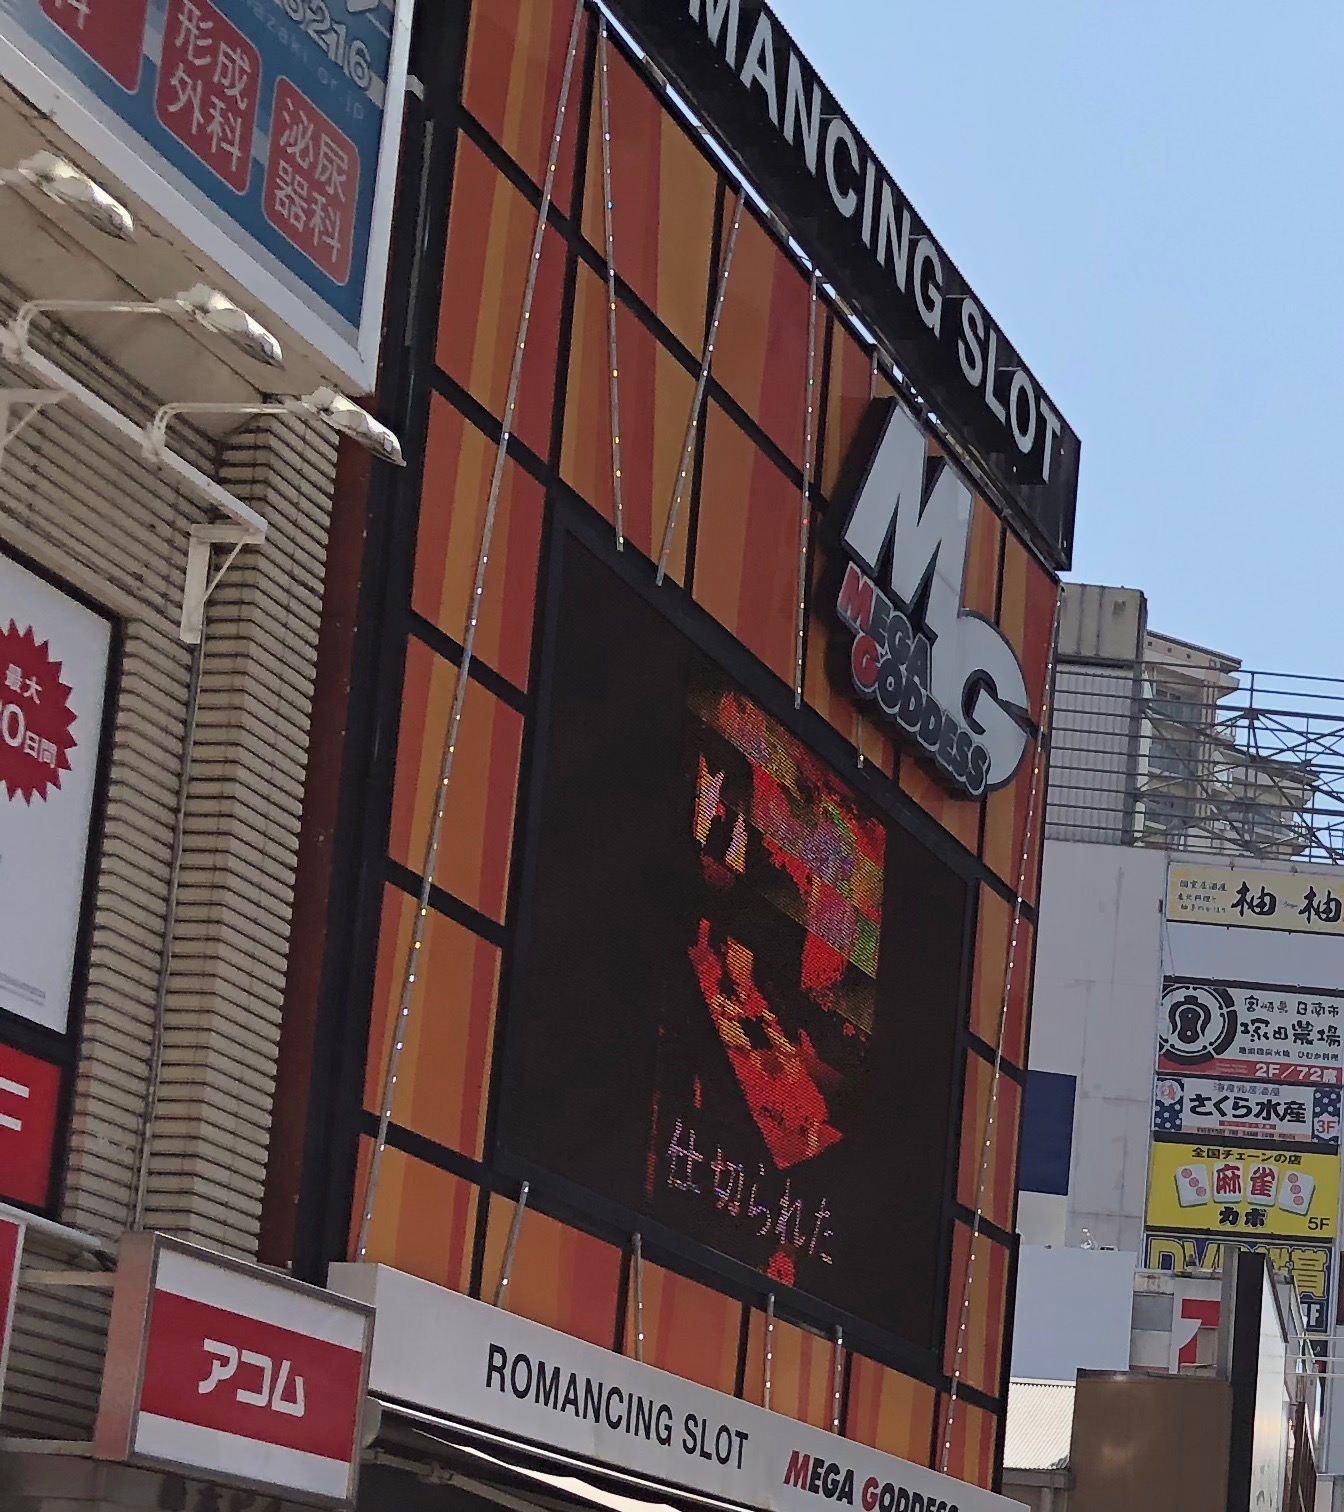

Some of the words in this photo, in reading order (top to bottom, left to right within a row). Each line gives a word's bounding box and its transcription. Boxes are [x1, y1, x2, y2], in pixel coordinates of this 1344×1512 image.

[174, 2, 251, 110] 形成
[168, 62, 242, 172] 外科
[279, 97, 348, 202] 泌尿
[273, 158, 341, 263] 器科
[958, 297, 1061, 484] SLOT
[837, 562, 934, 696] MEGA
[0, 700, 57, 769] 0日間
[851, 632, 990, 797] GODDESS
[1239, 1017, 1341, 1047] 塚田農場
[1296, 1000, 1339, 1018] 日南市
[1188, 1093, 1307, 1124] さくら水産
[1315, 1119, 1337, 1135] 3F
[1191, 1147, 1303, 1166] 全国チェーンの店
[1215, 1164, 1276, 1198] 麻雀
[1218, 1206, 1267, 1228] カボ
[1307, 1217, 1331, 1231] 5F
[198, 1337, 305, 1418] アコム
[485, 1342, 673, 1447] ROMANCING
[682, 1413, 750, 1470] SLOT
[782, 1449, 855, 1506] MEGA
